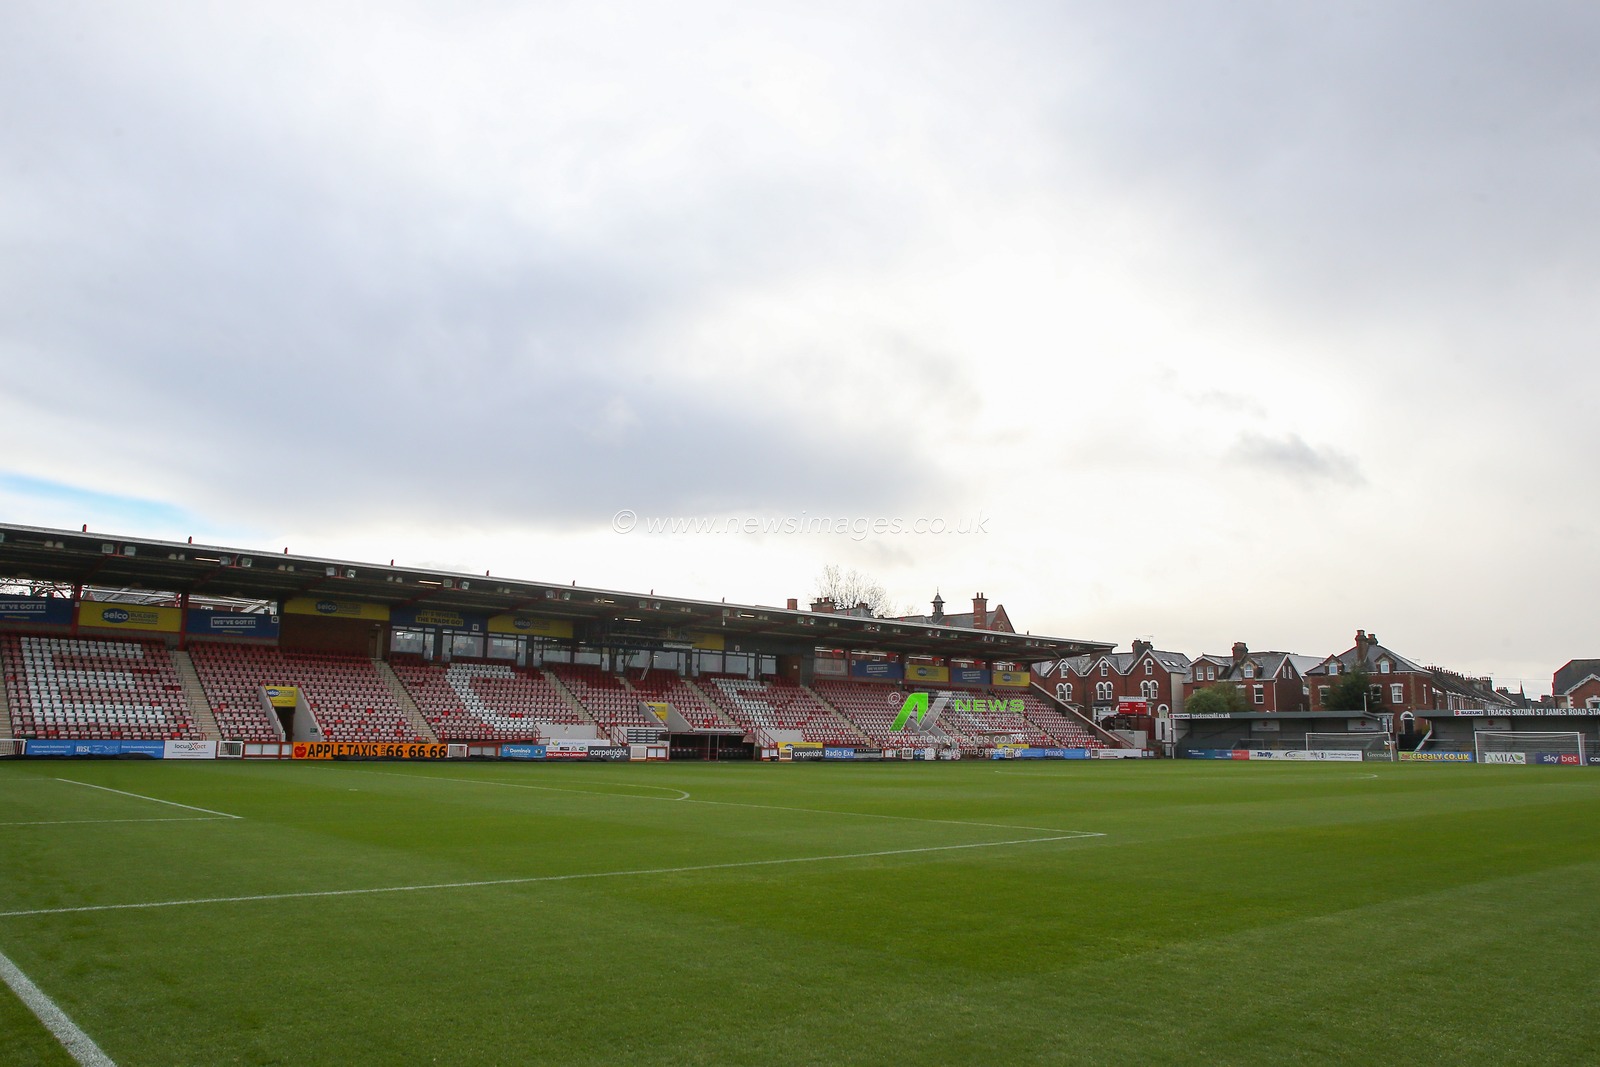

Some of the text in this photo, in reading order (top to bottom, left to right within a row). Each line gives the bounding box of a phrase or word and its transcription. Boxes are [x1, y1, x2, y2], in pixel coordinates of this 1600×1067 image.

[103, 609, 129, 620] selco
[307, 744, 378, 757] APPLE TAXIS
[825, 749, 842, 757] Radio
[843, 749, 854, 757] Exe
[1044, 748, 1064, 757] Pinnacle
[1543, 754, 1577, 763] sky bet
